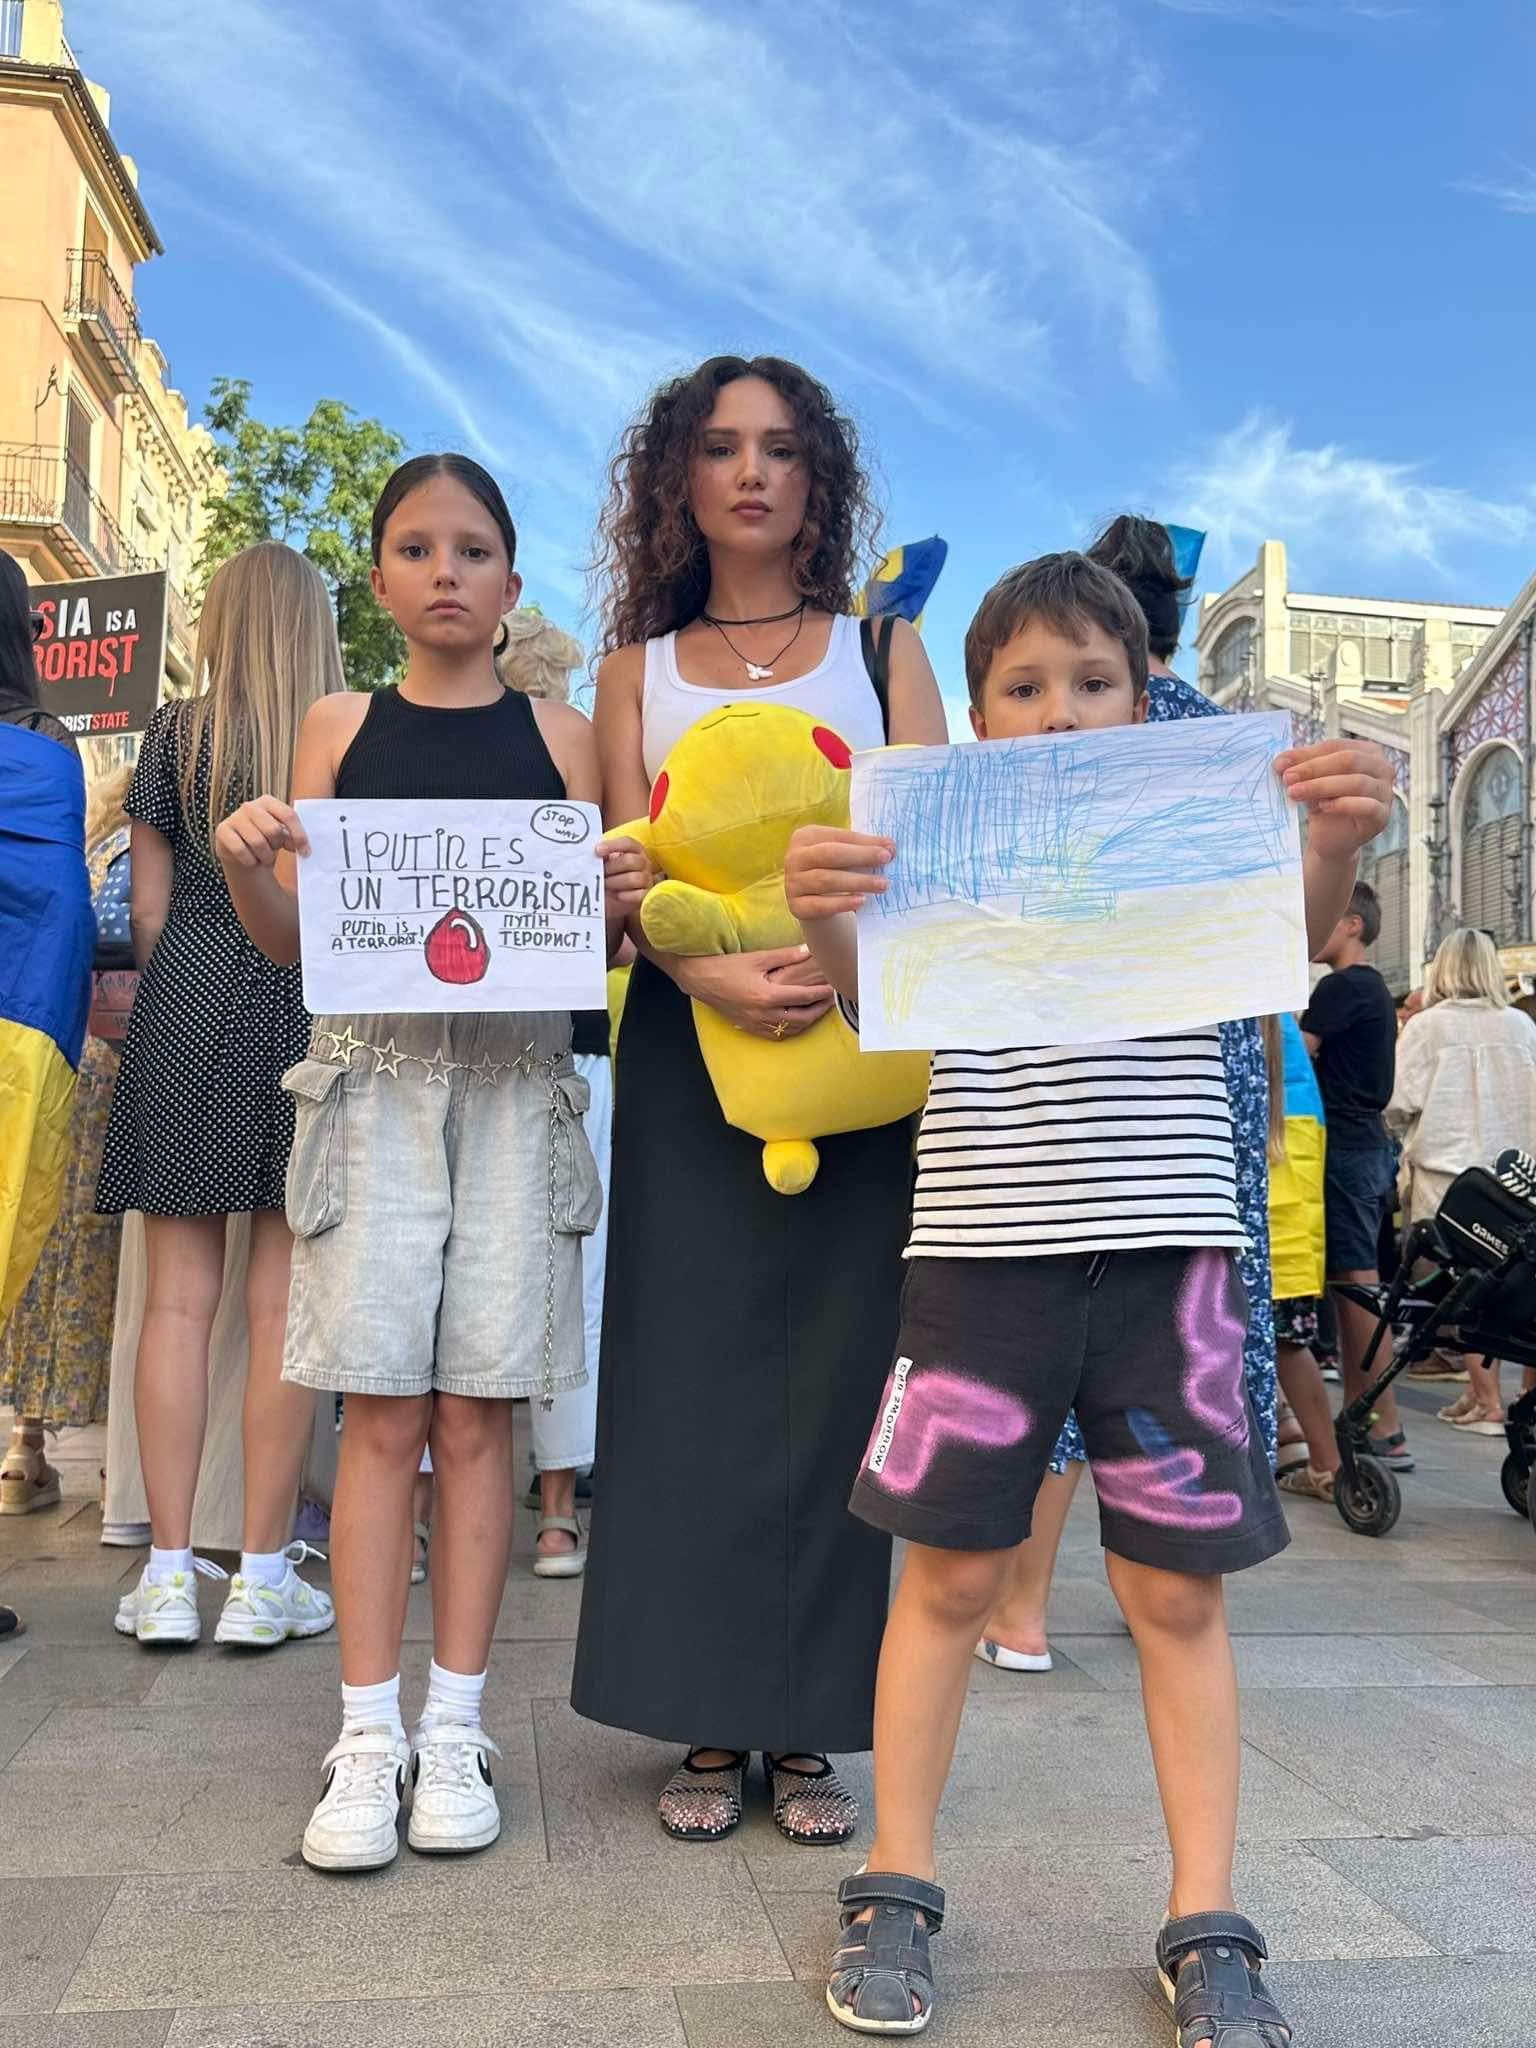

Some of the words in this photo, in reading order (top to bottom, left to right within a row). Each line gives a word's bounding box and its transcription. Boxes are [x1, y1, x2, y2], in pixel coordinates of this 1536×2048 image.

[106, 610, 122, 632] IS
[125, 608, 136, 630] A
[481, 836, 525, 869] ES
[341, 876, 382, 910] UN
[331, 937, 343, 951] A
